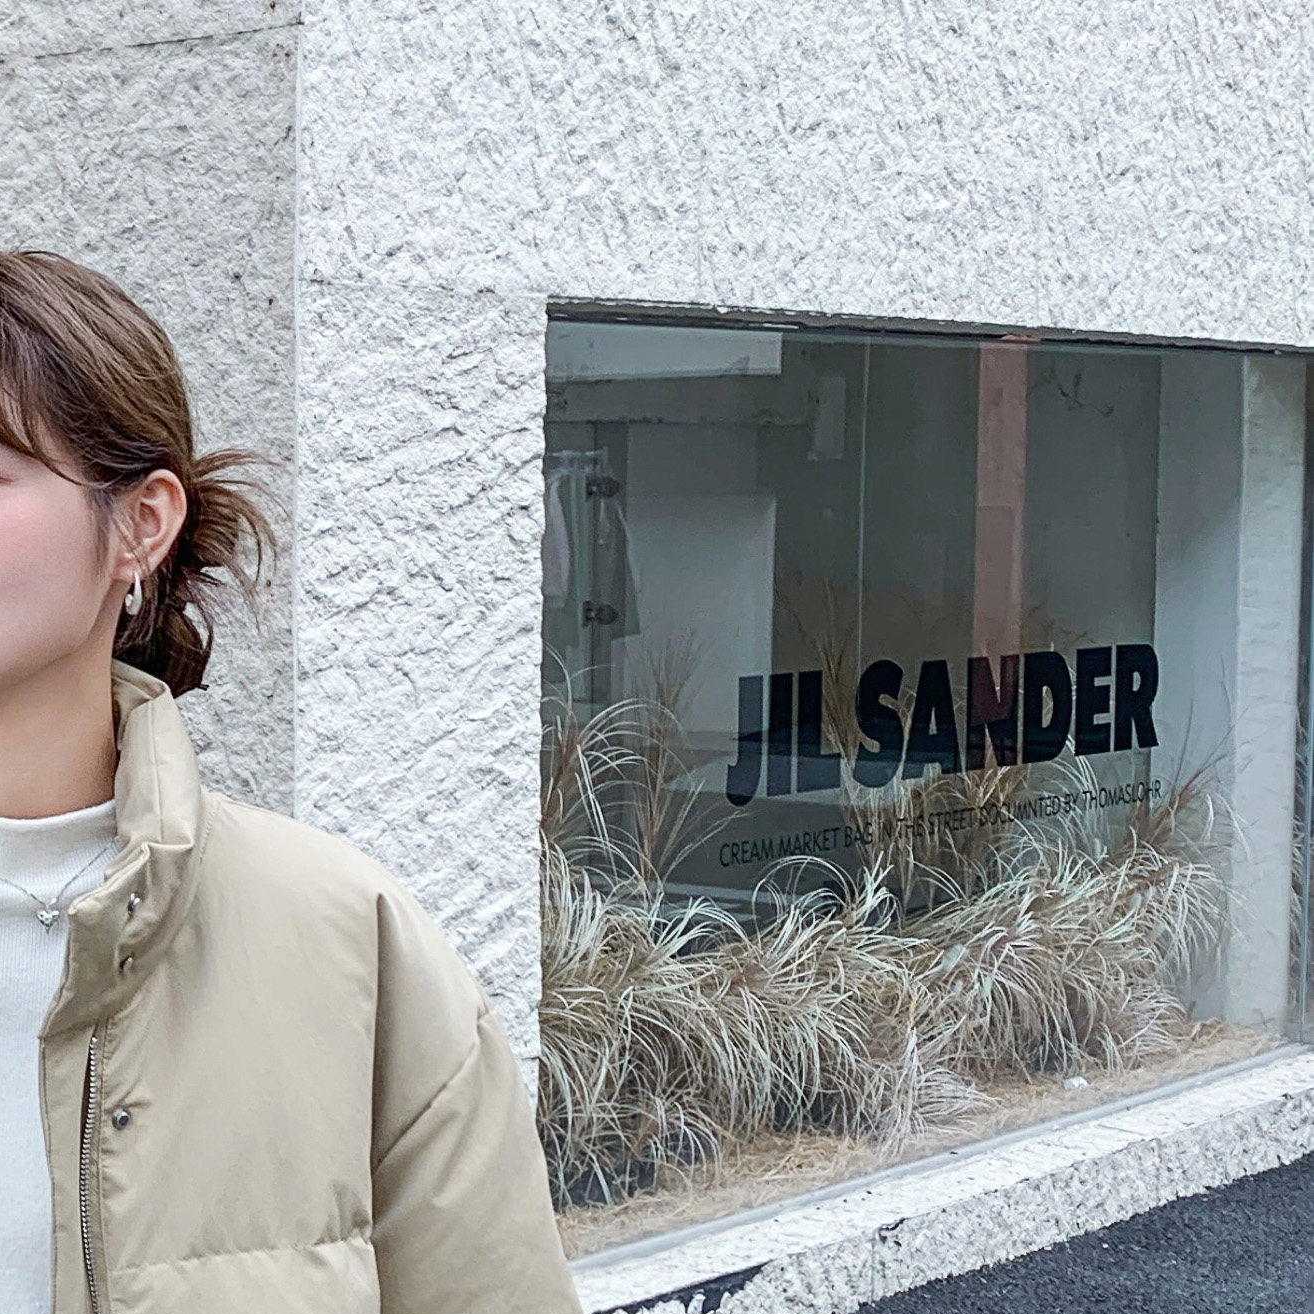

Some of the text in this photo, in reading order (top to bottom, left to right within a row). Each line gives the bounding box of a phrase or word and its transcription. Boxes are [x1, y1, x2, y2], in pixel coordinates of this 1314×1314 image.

[726, 643, 1159, 807] JIL SANDER
[719, 839, 775, 868] CREAM
[778, 827, 840, 857] MARKET
[844, 822, 873, 847] BAG
[879, 818, 892, 842] IN
[927, 807, 976, 836] STREET
[1064, 791, 1080, 814] BY
